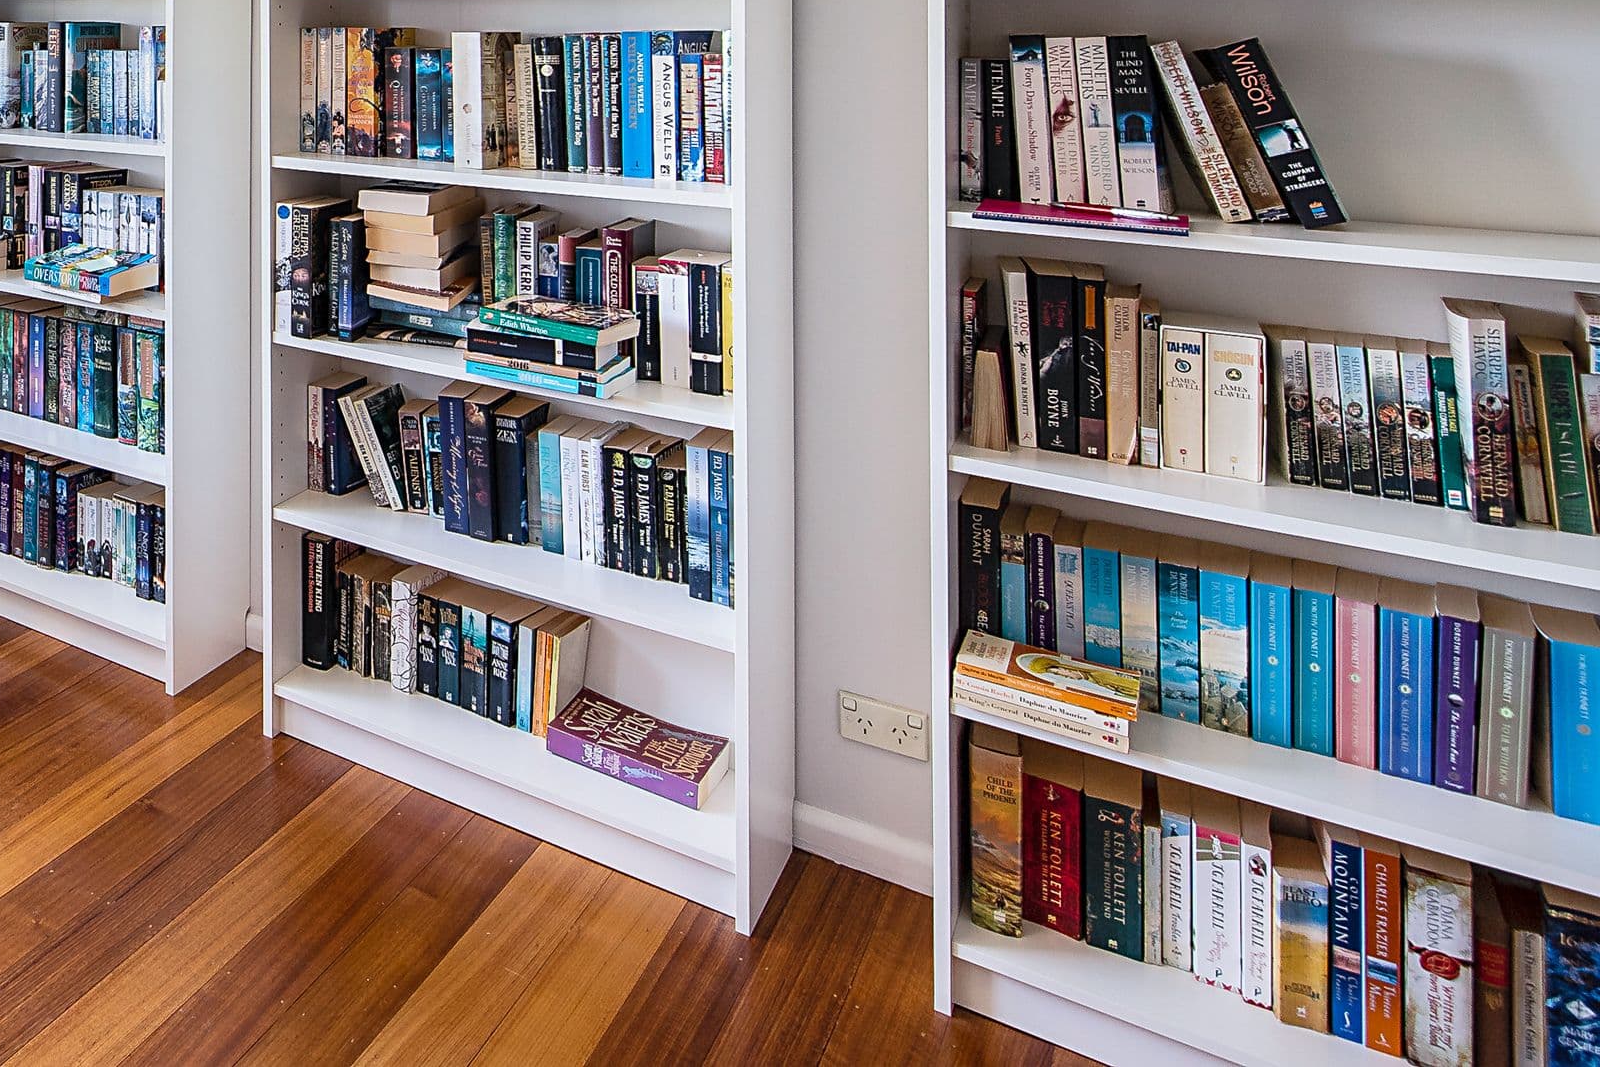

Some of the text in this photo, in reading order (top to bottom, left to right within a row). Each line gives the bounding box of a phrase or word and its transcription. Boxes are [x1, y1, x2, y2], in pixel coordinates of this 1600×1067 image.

[48, 28, 58, 58] FEIST
[572, 40, 582, 70] TOLKIEN
[591, 40, 601, 70] TOLKIEN
[609, 39, 619, 69] TOLKIEN
[636, 52, 646, 115] ANGUS WELLS
[990, 69, 1005, 118] TEMPLE
[1048, 45, 1062, 95] WALTERS
[1058, 44, 1074, 94] MINETTE
[1078, 45, 1096, 100] WALTERS
[1091, 43, 1109, 100] MINETTE
[1227, 44, 1273, 116] Wilson
[1257, 73, 1277, 102] Robert
[662, 62, 675, 161] ANGUS WELLS
[681, 62, 699, 132] BEHEMOTH
[704, 64, 723, 132] LEVIATHAN
[1021, 67, 1039, 162] Forty Days Shadow
[1179, 91, 1207, 136] WILSON
[1089, 143, 1100, 177] MINDS
[1099, 130, 1113, 192] DISORDERED
[62, 173, 71, 211] GOODKIND
[69, 180, 78, 204] TERRY
[1208, 174, 1232, 211] DAMNED
[292, 208, 303, 262] GREGORY
[301, 213, 311, 259] PHILIPPA
[330, 231, 341, 285] ALEX MILLER
[519, 226, 534, 292] PHILIP KERR
[33, 265, 78, 287] OVERSTORY
[499, 318, 549, 336] Edith Wharton
[1017, 299, 1029, 337] HAVOC
[1473, 334, 1489, 381] HAVOC
[1486, 327, 1505, 389] SHARPE'S
[1021, 386, 1030, 417] BENNETT
[1047, 388, 1061, 428] BOYNE
[409, 455, 423, 497] ALIENIST
[581, 470, 591, 493] FURST
[713, 471, 724, 502] JAMES
[1477, 425, 1497, 502] CORNWELL
[1492, 432, 1510, 498] BERNARD
[612, 487, 626, 519] JAMES
[634, 492, 651, 525] JAMES
[971, 512, 984, 566] DUNANT
[982, 527, 993, 554] SARAH
[306, 541, 315, 614] Different Seasons
[314, 542, 323, 613] STEPHEN KING
[714, 544, 724, 589] LIGHTHOUSE
[1036, 536, 1046, 598] DOROTHY DUNNETT
[1400, 617, 1411, 680] DOROTHY DUNNETT
[1451, 622, 1462, 689] DOROTHY DUNNETT
[1502, 639, 1515, 703] DOROTHY DUNNETT
[1019, 695, 1088, 721] Daphne Maurier
[1023, 711, 1092, 737] Daphne Maurier
[987, 776, 1014, 788] CHILD
[1050, 811, 1062, 908] KEN FOLLETT
[1103, 829, 1112, 919] WORLD END
[1113, 831, 1126, 926] KEN FOLLETT
[1334, 849, 1349, 945] MOUNTAIN
[1350, 877, 1359, 910] COLD
[1375, 863, 1388, 958] CHARLES FRAZIER
[1425, 888, 1442, 949] GABALDON
[1440, 904, 1456, 941] DIANA
